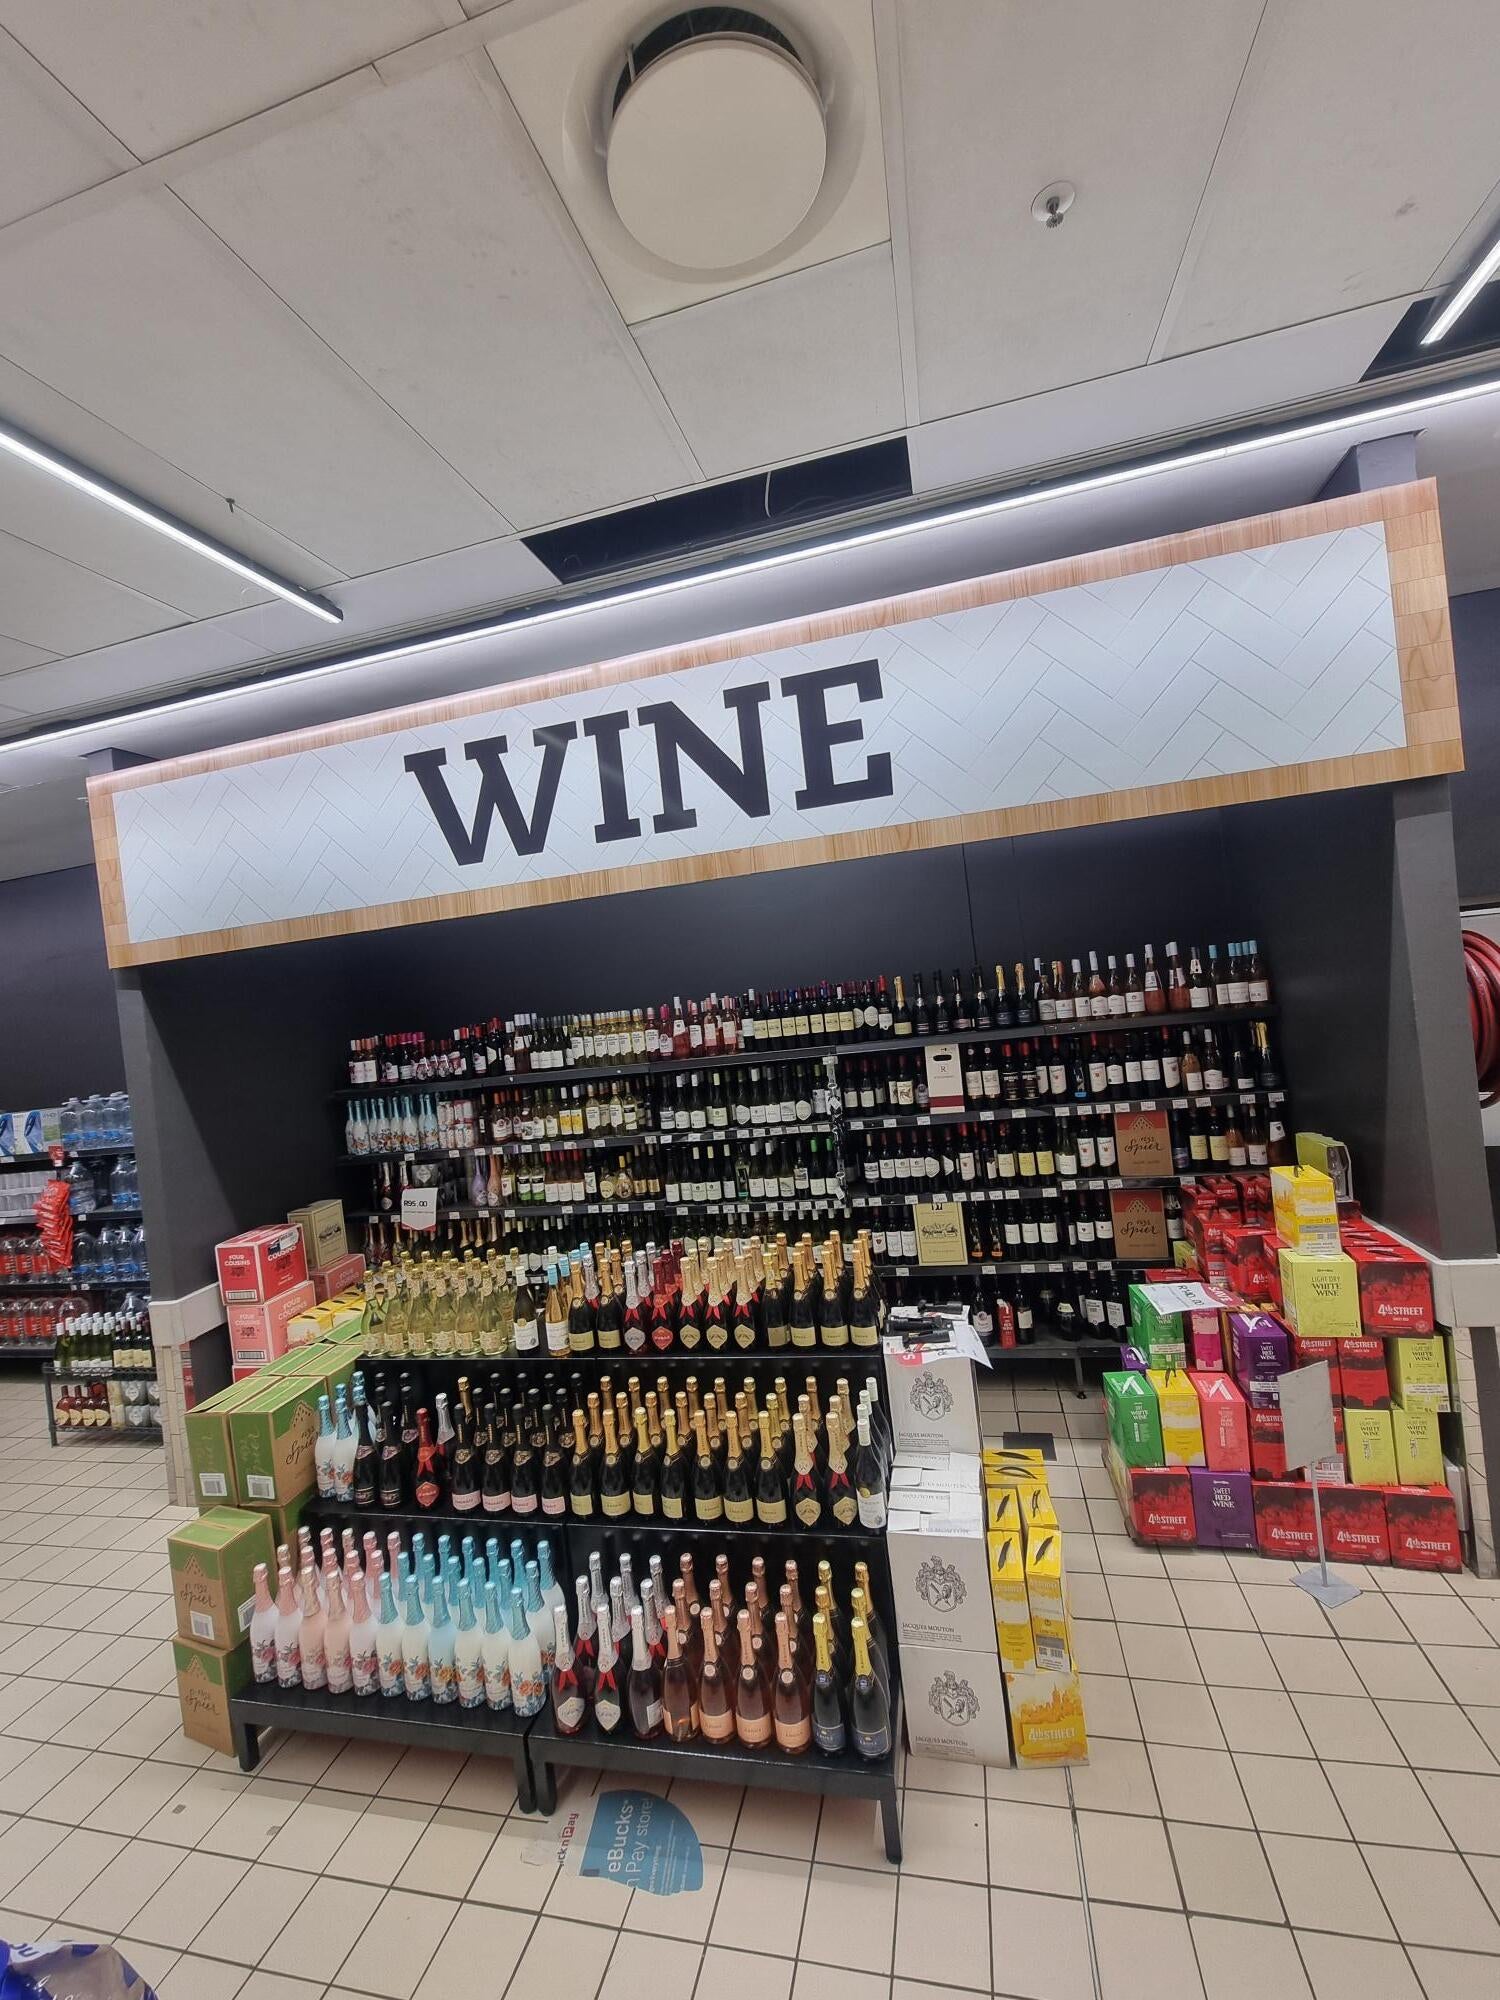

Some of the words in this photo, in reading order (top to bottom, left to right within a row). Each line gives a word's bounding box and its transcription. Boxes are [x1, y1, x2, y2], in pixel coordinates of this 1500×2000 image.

[403, 658, 894, 866] WINE
[1124, 1138, 1164, 1156] Spier
[1120, 1221, 1161, 1238] Spier
[1312, 1282, 1341, 1290] WHITE
[1316, 1289, 1339, 1297] WINE
[1213, 1487, 1231, 1495] SWEET
[1212, 1500, 1235, 1509] WINE
[902, 1622, 927, 1630] JACQUES
[927, 1624, 955, 1633] MOUTON
[625, 1840, 650, 1873] Pay
